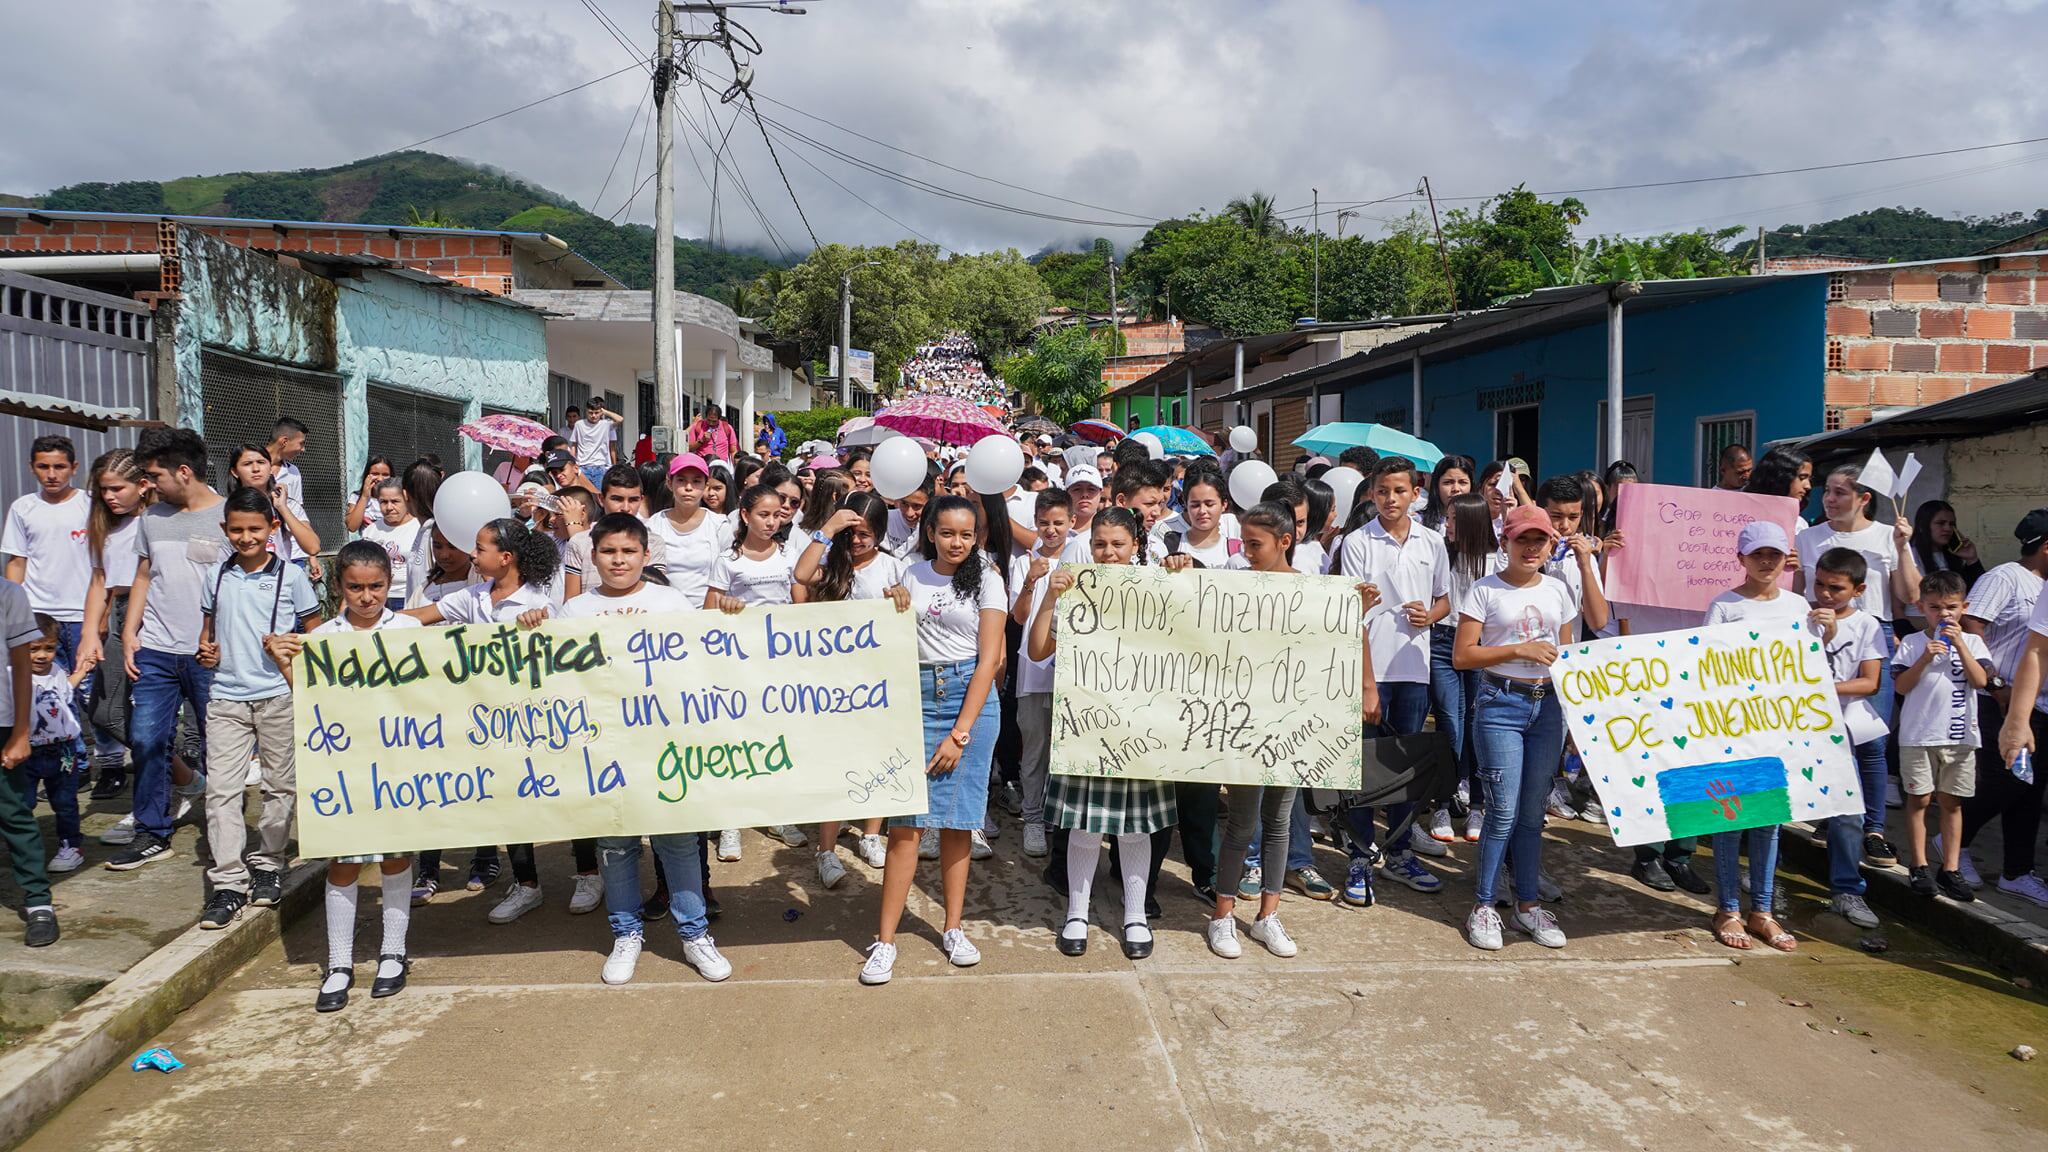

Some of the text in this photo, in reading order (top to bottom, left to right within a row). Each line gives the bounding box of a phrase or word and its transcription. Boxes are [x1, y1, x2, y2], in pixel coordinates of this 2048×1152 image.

[1689, 527, 1705, 537] ES
[1677, 560, 1696, 570] DEL
[1068, 568, 1360, 638] Señor, hazme un
[301, 631, 430, 689] Nada
[626, 628, 688, 687] que
[700, 628, 749, 660] en
[765, 613, 881, 659] busca
[1072, 637, 1356, 704] instrumento de tu
[1561, 639, 1821, 705] CONSEJO MUNICIPAL
[307, 704, 350, 755] de
[380, 713, 445, 749] una
[621, 693, 670, 727] un
[681, 685, 747, 724] niño
[761, 679, 889, 715] conozca
[1179, 697, 1254, 752] PAZ
[1605, 692, 1834, 753] DE JUVENTUDES
[1949, 714, 1966, 740] YOU
[1952, 690, 1966, 708] ON
[1099, 728, 1167, 775] Niñas,
[1251, 713, 1329, 768] Jóvenes,
[310, 734, 794, 816] el horror de la guerra
